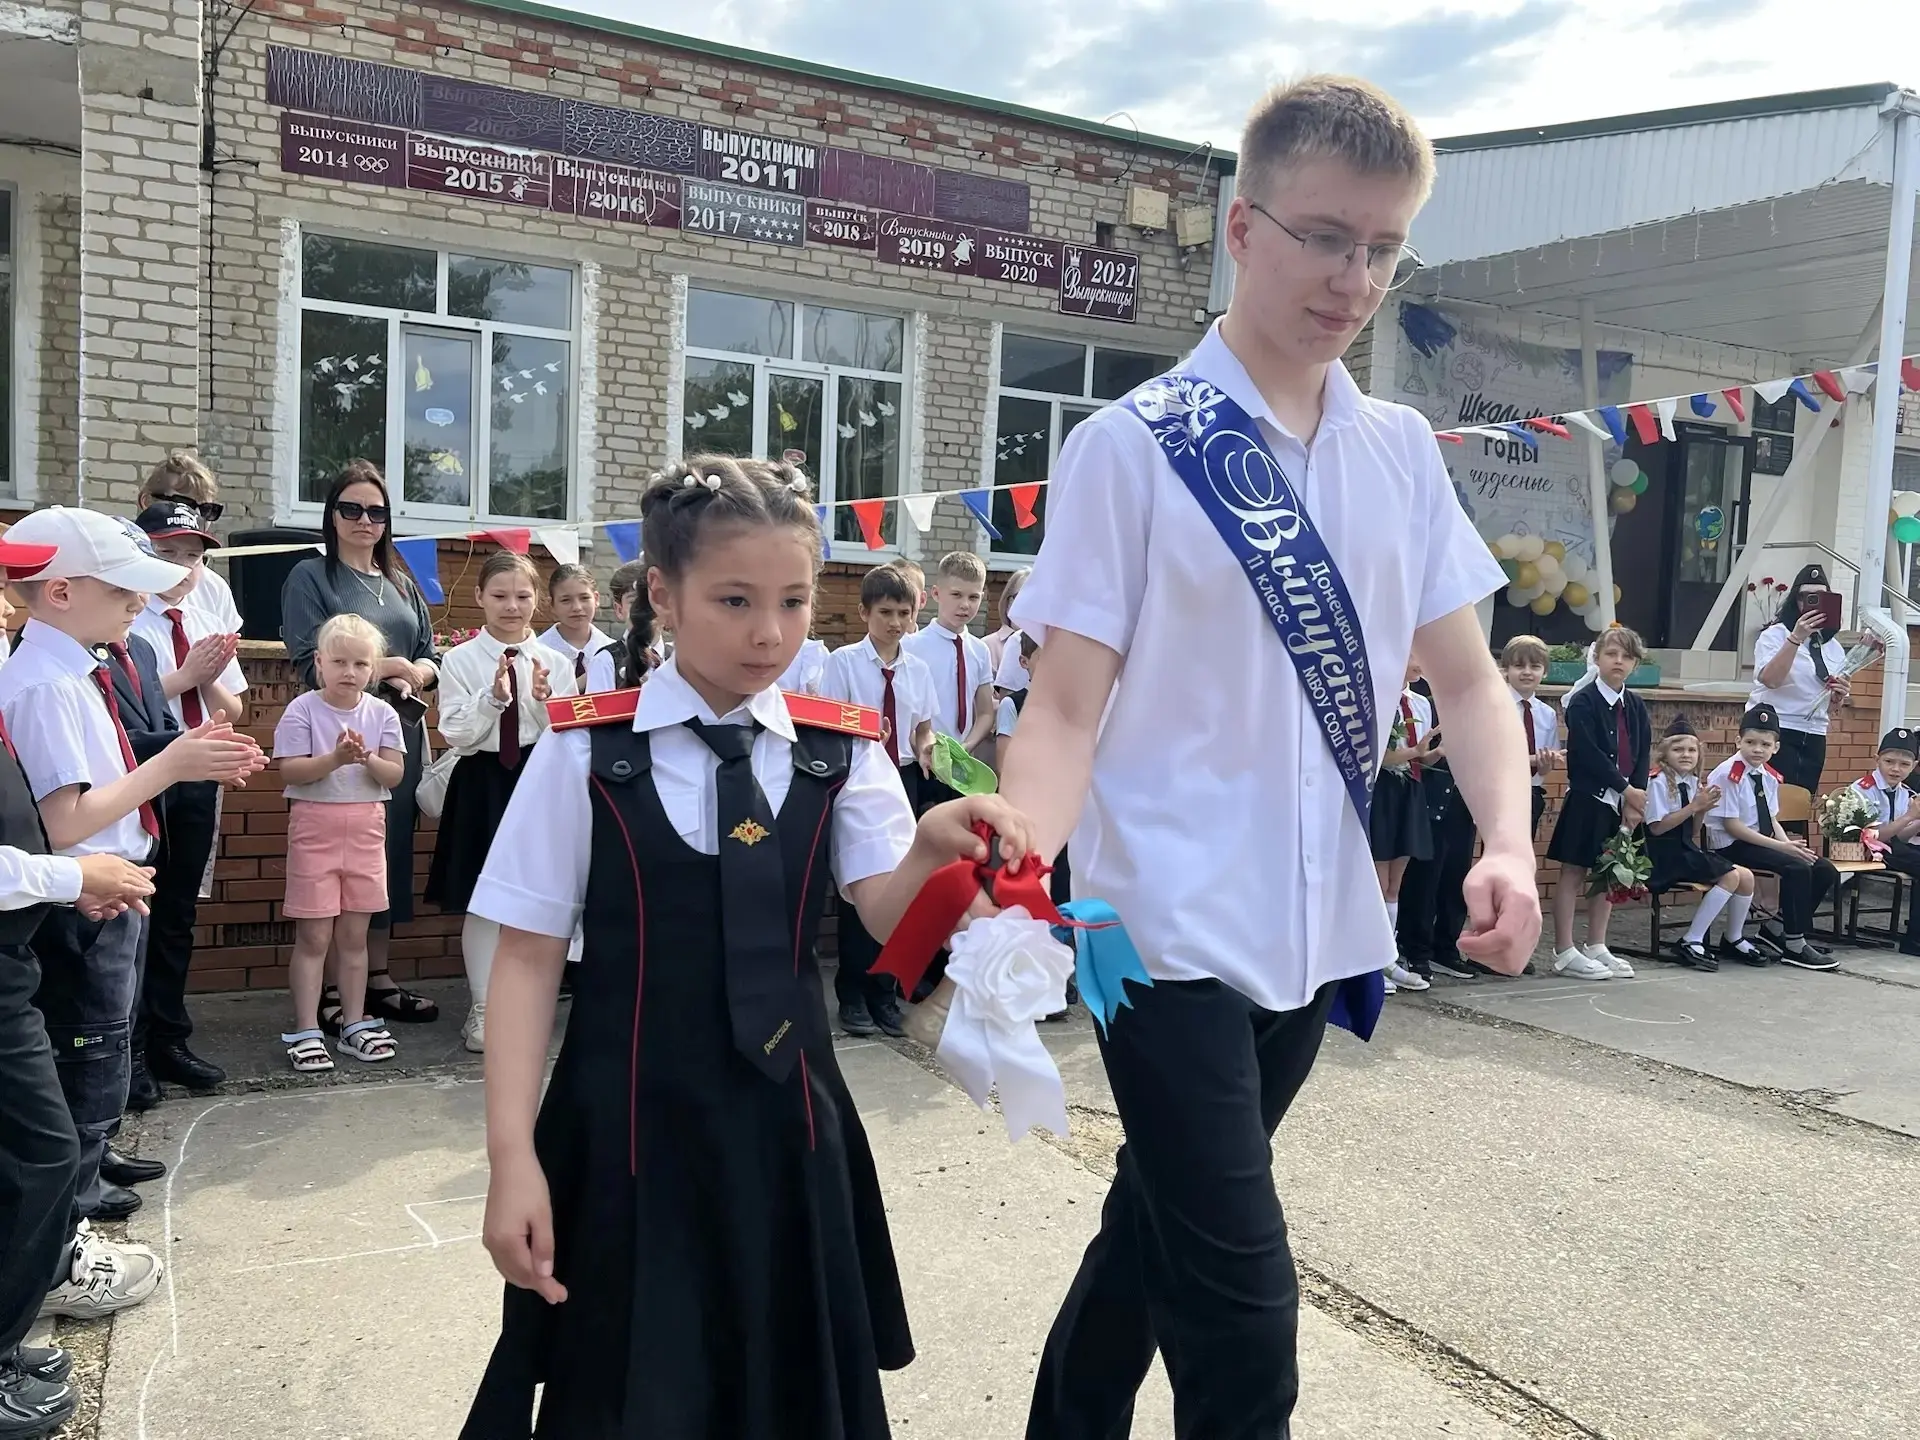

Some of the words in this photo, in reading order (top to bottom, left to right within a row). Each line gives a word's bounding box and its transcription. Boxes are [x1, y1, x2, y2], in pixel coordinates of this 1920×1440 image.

[289, 124, 398, 150] ВЫПУСКНИКИ
[702, 129, 815, 169] ВЫПУСКНИКИ
[299, 146, 349, 168] 2014
[414, 142, 544, 176] ВЫПУСКНИКИ
[445, 166, 504, 194] 2015
[556, 160, 676, 193] Выпускники
[721, 156, 797, 190] 2011
[589, 191, 645, 214] 2016
[689, 185, 801, 216] ВЫПУСКНИКИ
[816, 207, 868, 223] ВЫПУСК
[687, 205, 742, 234] 2017
[823, 221, 860, 241] 2018
[880, 216, 953, 241] Выпускники
[899, 237, 945, 259] 2019
[985, 243, 1055, 268] ВЫПУСК
[1000, 262, 1038, 283] 2020
[1091, 259, 1137, 289] 2021
[1064, 265, 1134, 314] Выпускницы
[1469, 468, 1554, 499] чудесные
[1246, 553, 1266, 570] 11
[1256, 573, 1290, 625] класс
[1203, 430, 1376, 793] Выпускник
[1305, 560, 1360, 655] Донецкий
[1352, 656, 1373, 721] Роман
[1302, 665, 1332, 707] МБОУ
[1323, 712, 1346, 748] СОШ
